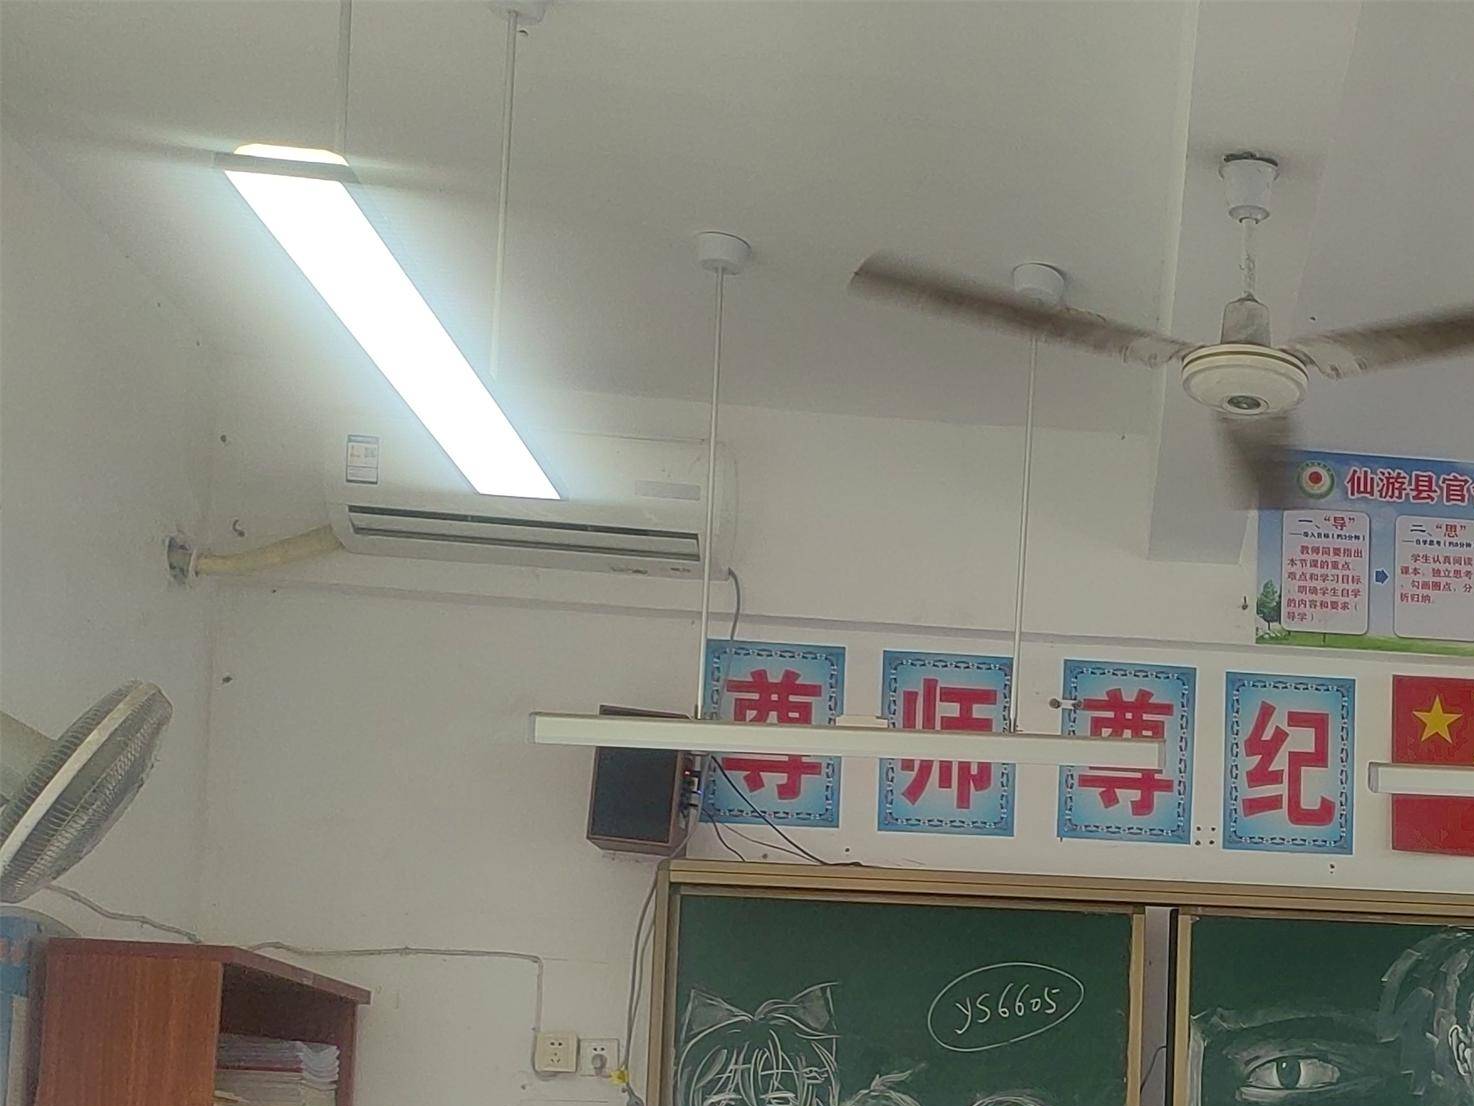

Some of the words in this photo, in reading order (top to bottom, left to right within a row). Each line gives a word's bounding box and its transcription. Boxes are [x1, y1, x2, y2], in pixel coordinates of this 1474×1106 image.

[1300, 545, 1363, 559] 教师简要指出
[1410, 552, 1473, 568] 学生认真阅读
